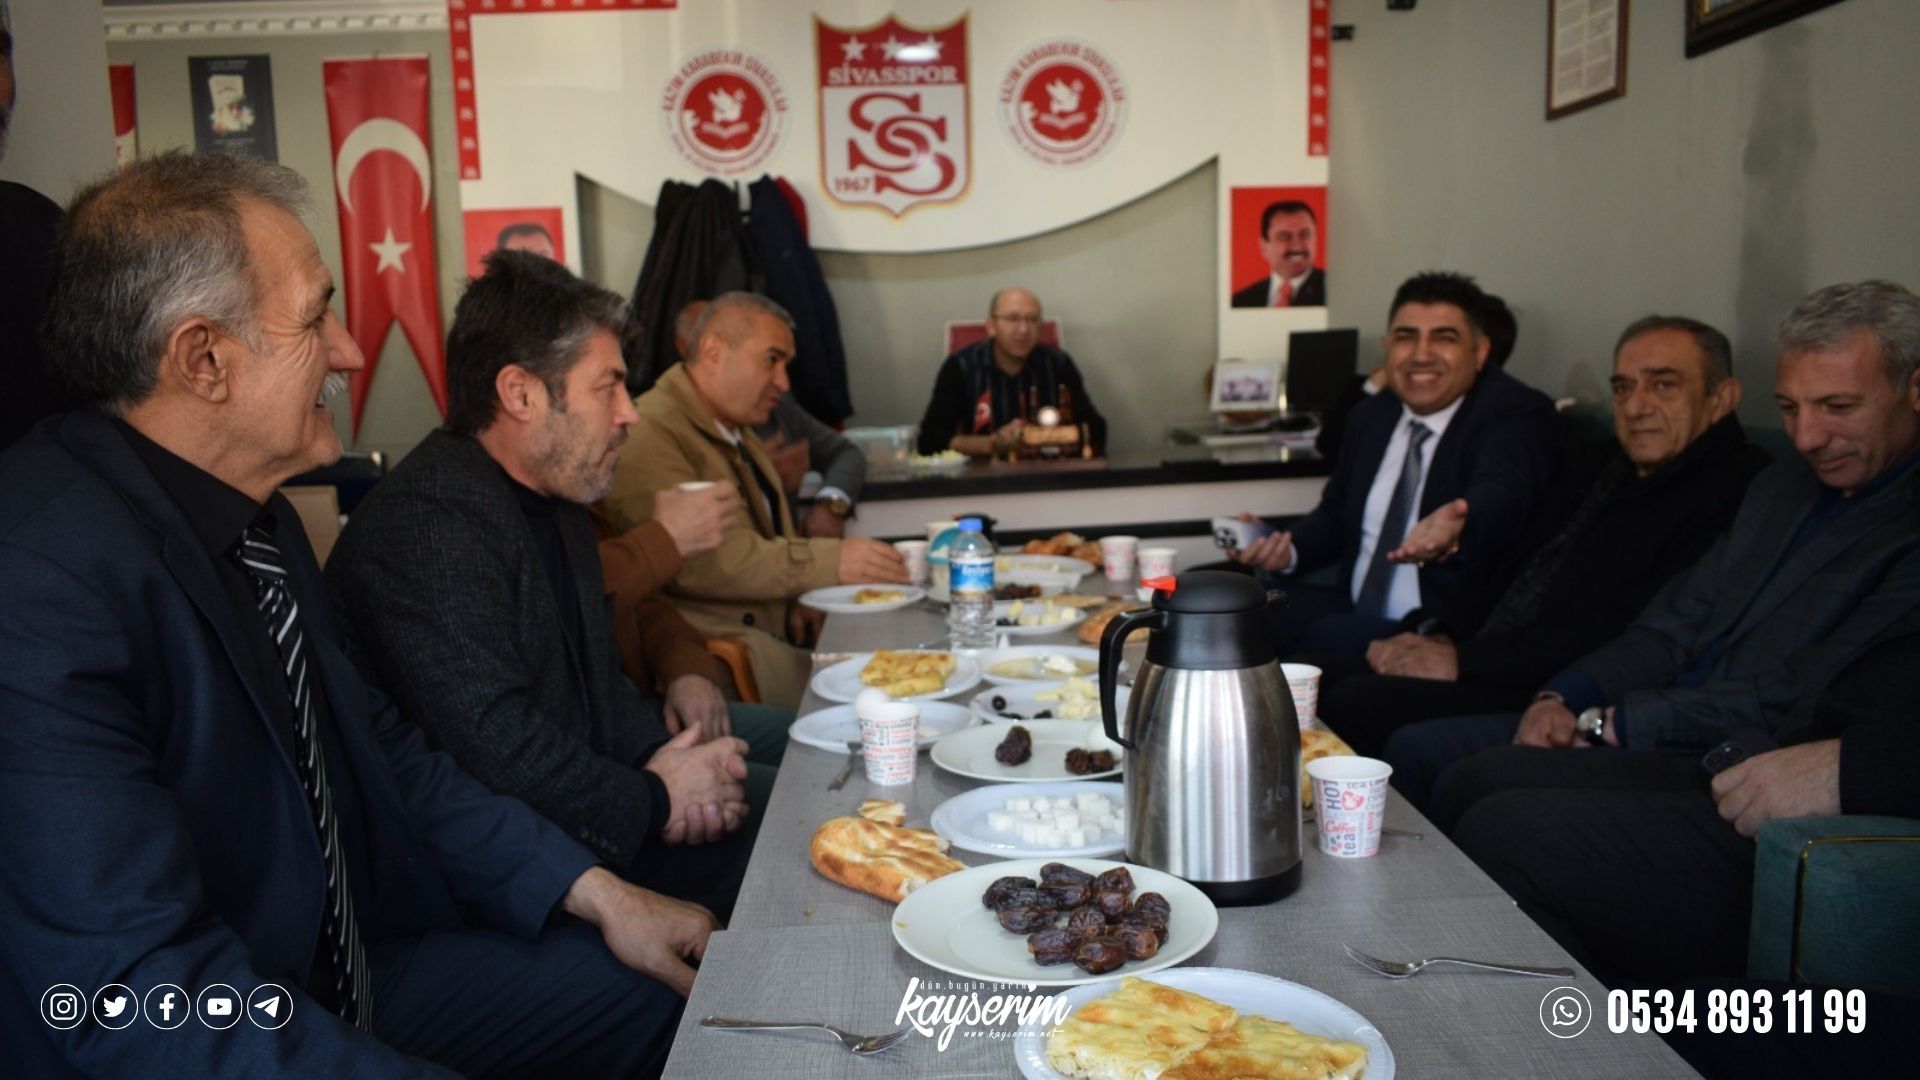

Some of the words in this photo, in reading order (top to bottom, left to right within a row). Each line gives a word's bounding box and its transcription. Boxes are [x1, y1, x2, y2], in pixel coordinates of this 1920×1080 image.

[827, 63, 957, 84] SİVASSPOR
[834, 177, 870, 192] 1967
[1342, 833, 1356, 856] tea
